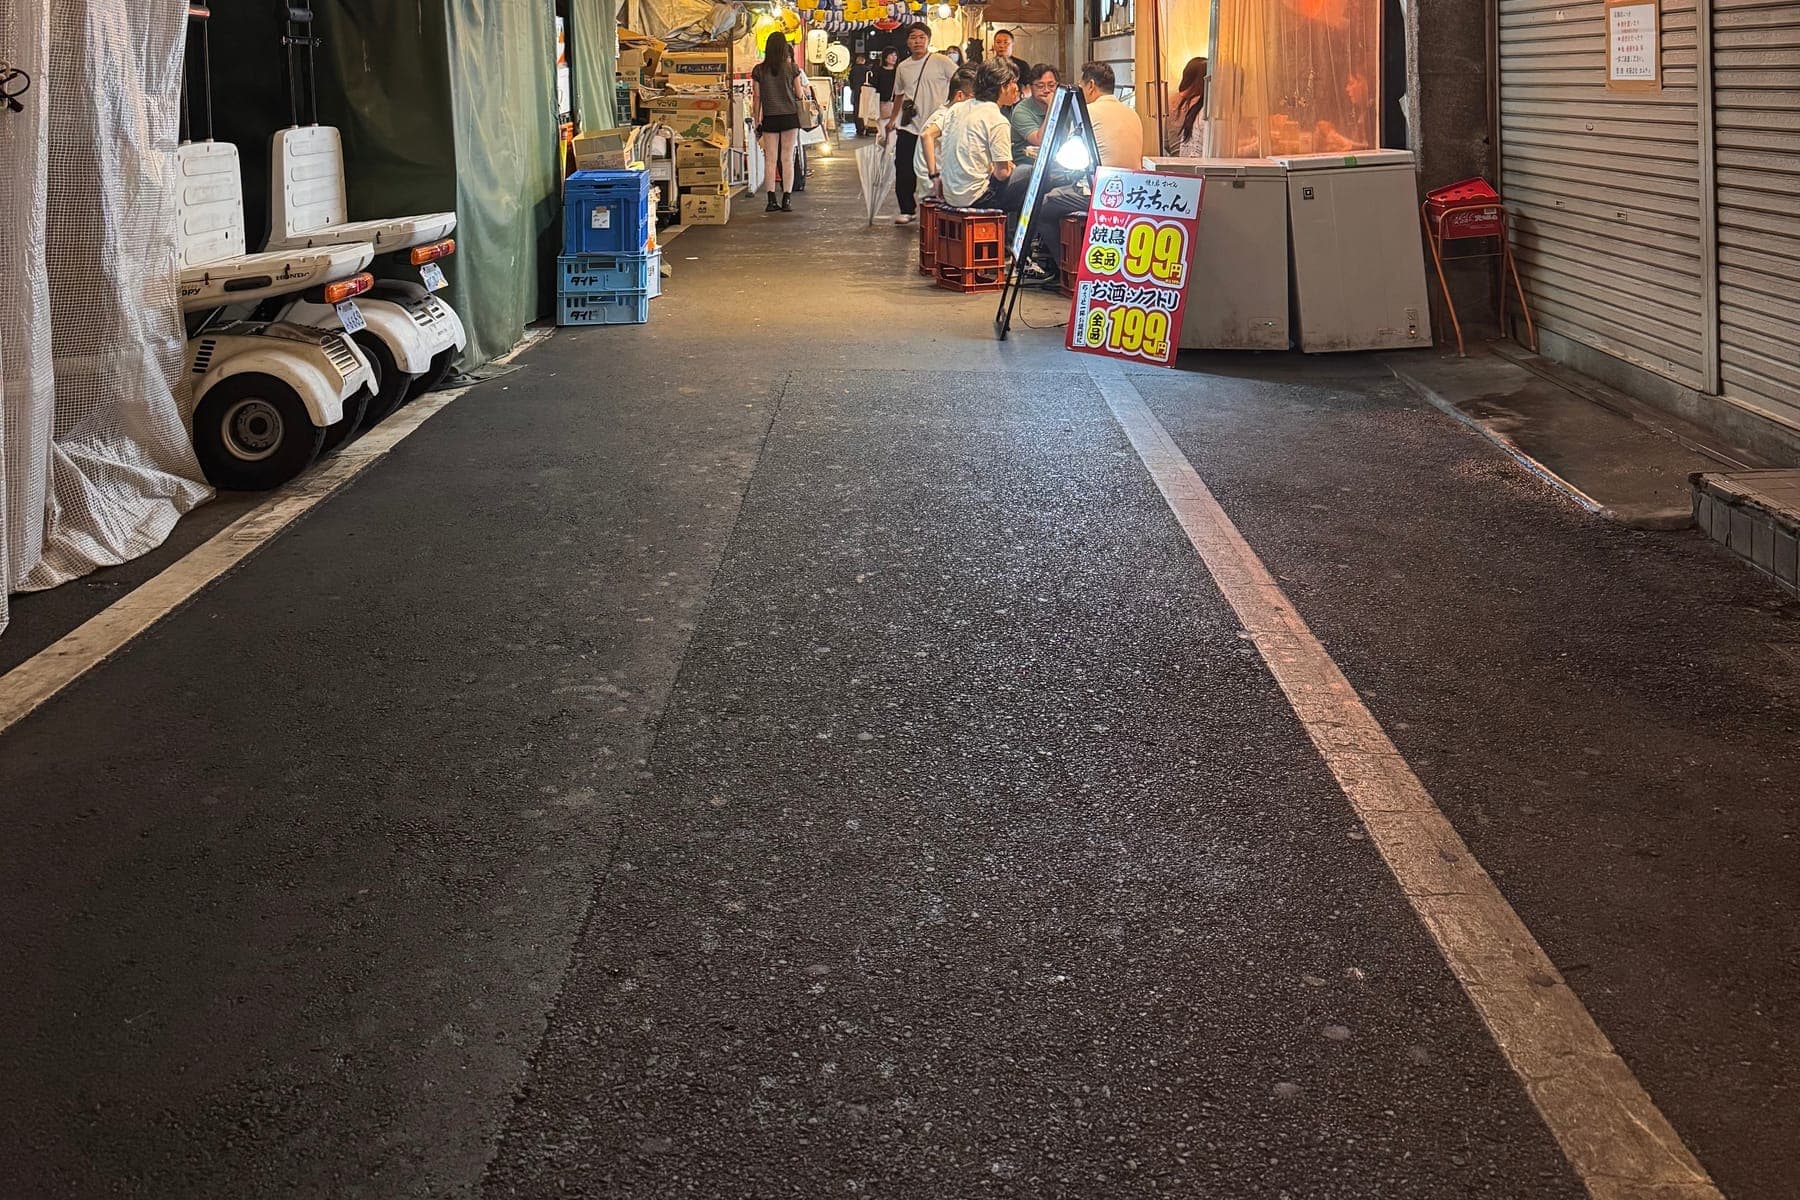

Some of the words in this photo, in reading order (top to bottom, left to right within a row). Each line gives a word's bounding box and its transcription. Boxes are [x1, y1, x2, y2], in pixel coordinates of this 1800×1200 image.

[1126, 185, 1188, 213] 坊っちゃん
[1091, 226, 1126, 246] 焼鳥
[1091, 249, 1116, 267] 全品
[1089, 313, 1104, 341] 全品
